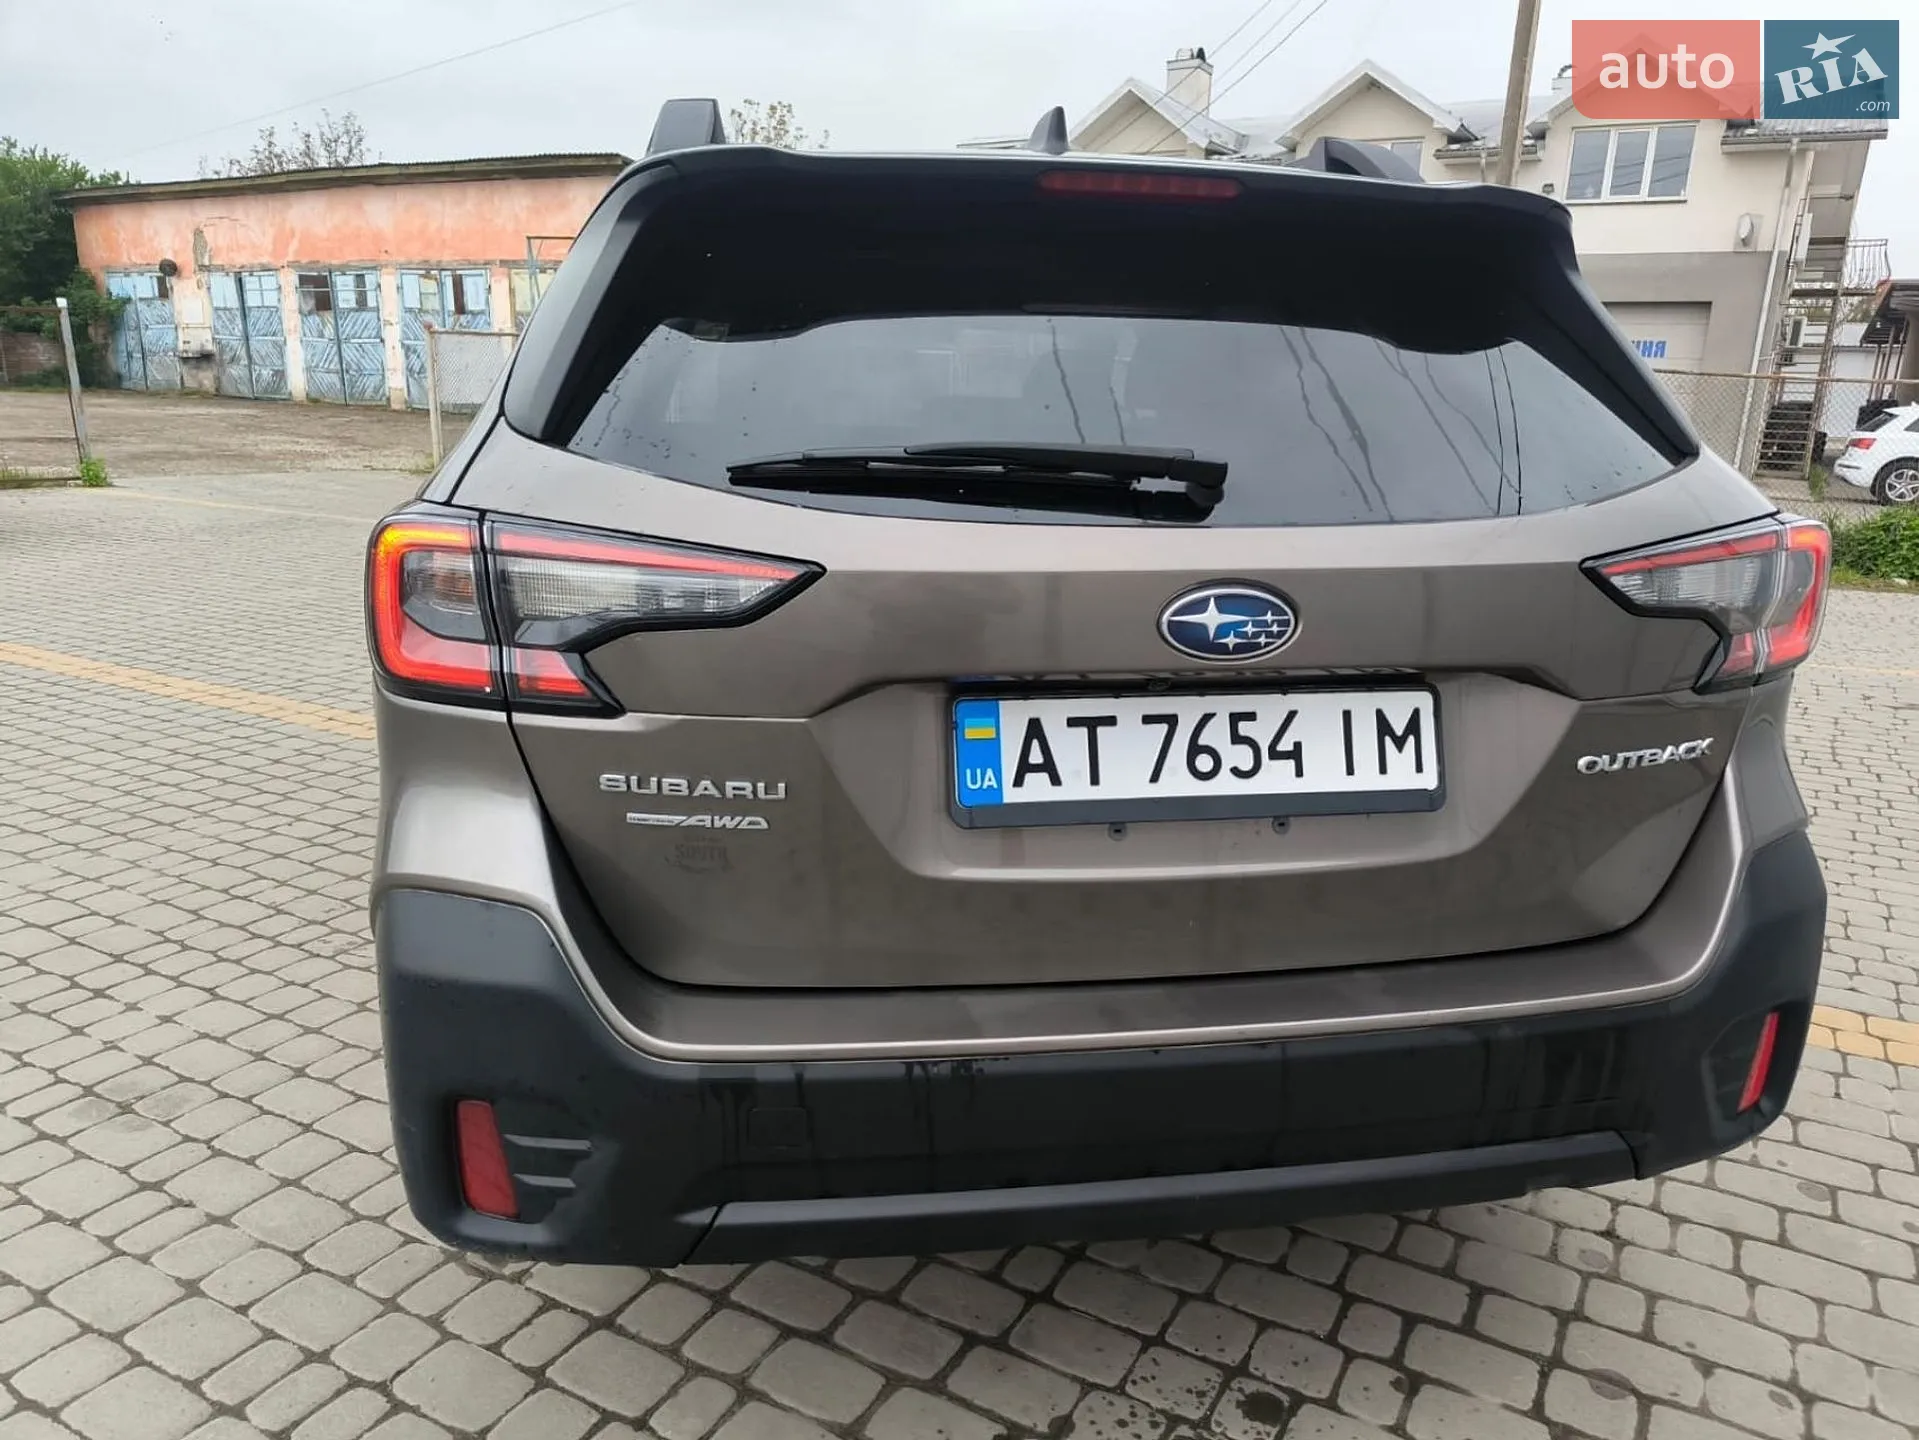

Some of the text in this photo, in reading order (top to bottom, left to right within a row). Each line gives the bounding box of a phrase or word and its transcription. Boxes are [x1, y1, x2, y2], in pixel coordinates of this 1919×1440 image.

[1012, 707, 1424, 788] AT 7654 IM
[1577, 737, 1714, 775] OUTBACK
[599, 773, 787, 800] SUBARU
[965, 768, 998, 790] UA
[679, 814, 769, 829] AWD
